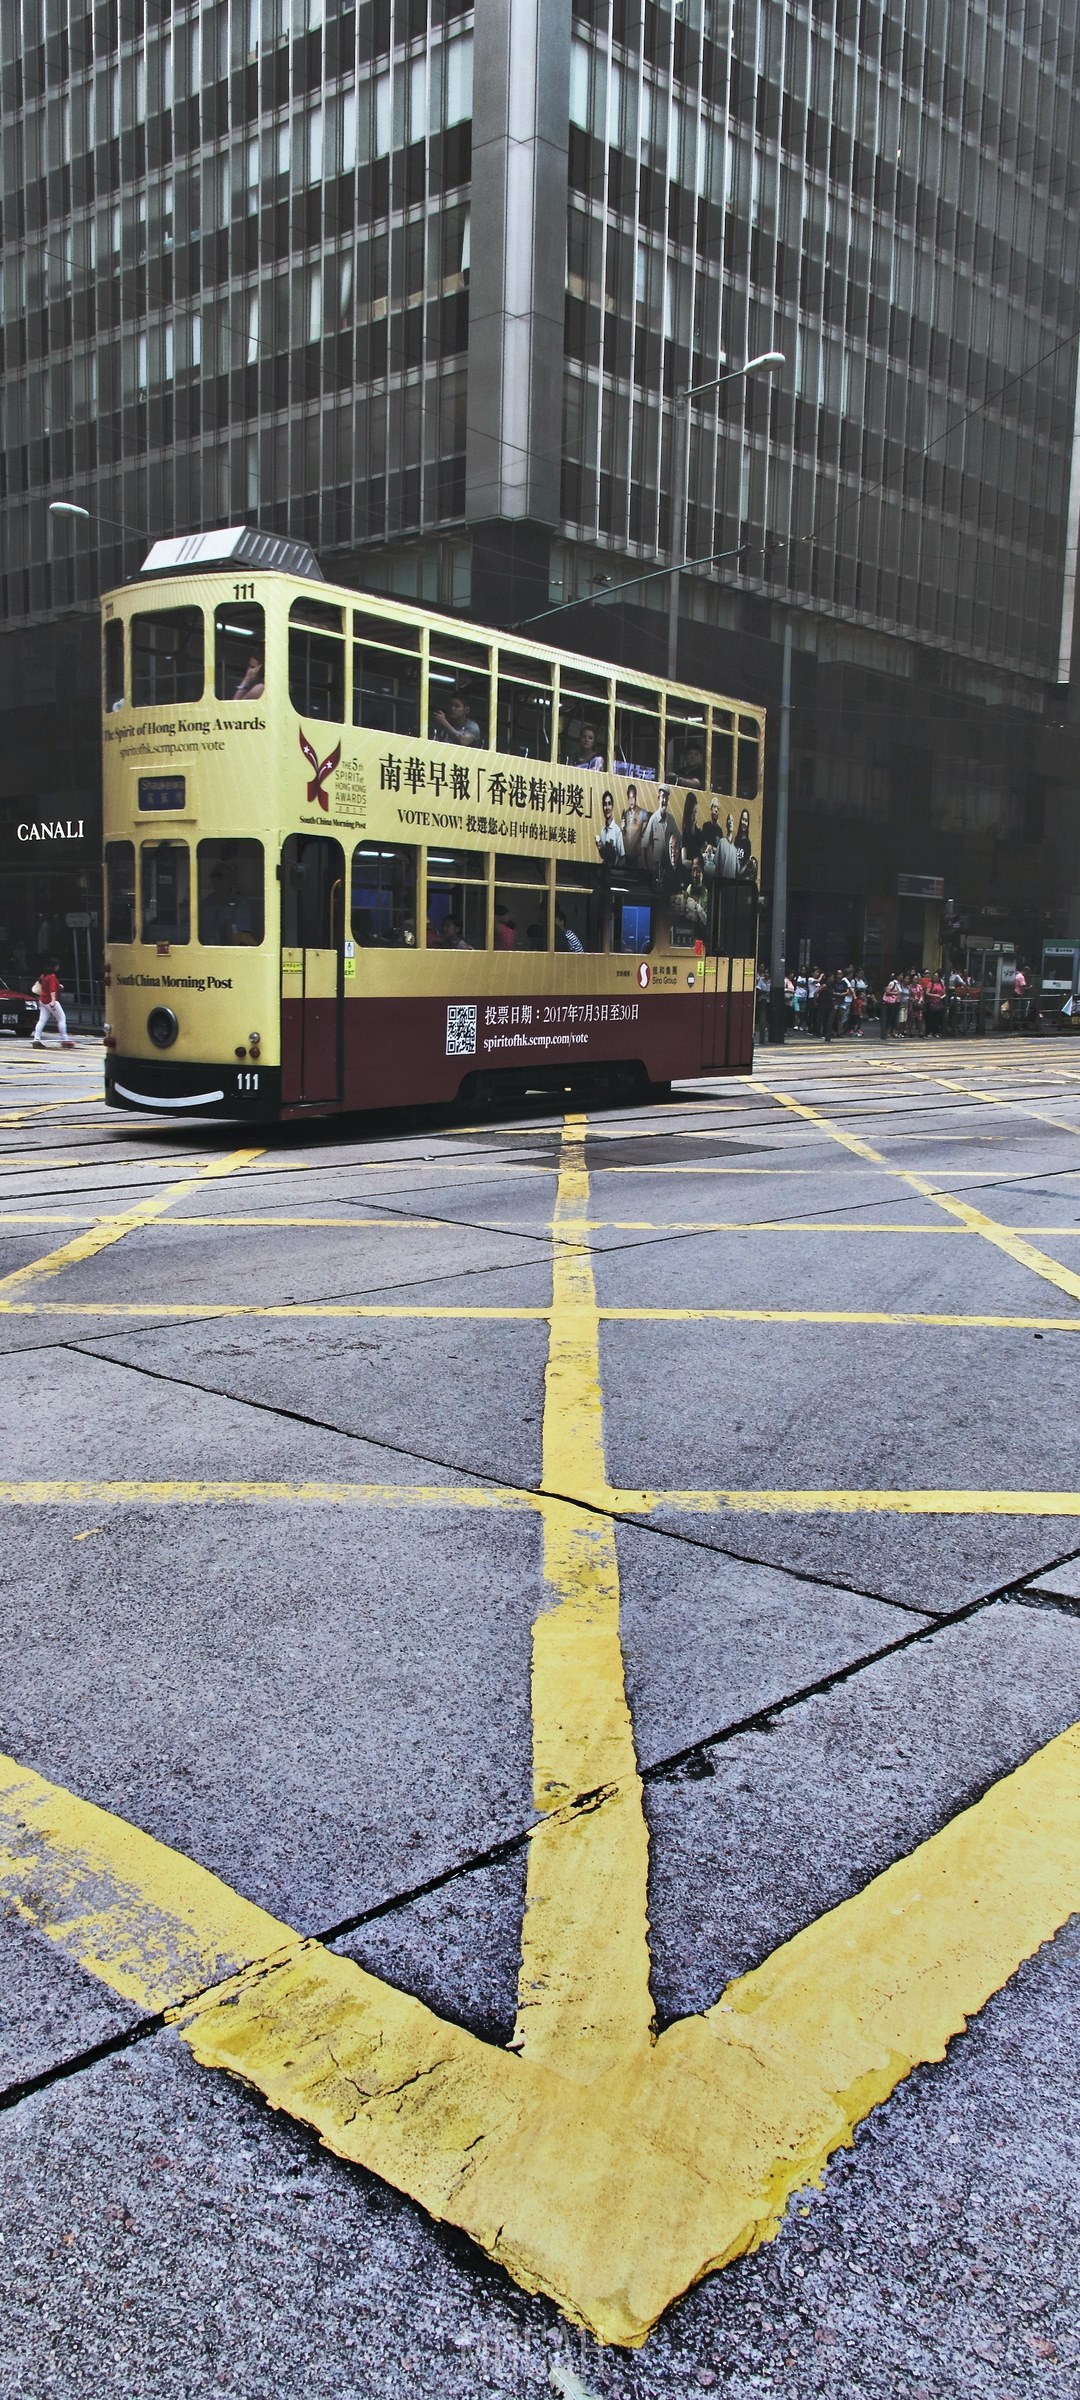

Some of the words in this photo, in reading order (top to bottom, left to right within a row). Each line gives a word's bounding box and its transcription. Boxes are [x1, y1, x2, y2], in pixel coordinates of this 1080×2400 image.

[233, 583, 255, 600] 111
[114, 726, 135, 743] Spirit
[137, 722, 147, 736] of
[148, 721, 176, 736] Hong
[178, 719, 211, 735] Kong
[213, 717, 266, 731] Awards
[342, 760, 352, 770] THE
[335, 770, 360, 782] SPIRIT
[335, 782, 351, 791] HONG
[352, 784, 367, 793] KONG
[335, 792, 367, 805] AWARDS
[299, 815, 316, 825] South
[316, 817, 332, 826] China
[332, 819, 355, 830] Morning
[355, 821, 366, 829] Post
[397, 809, 431, 826] VOTE
[431, 812, 463, 830] NOW!
[17, 820, 85, 841] CANALI
[116, 974, 135, 986] South
[135, 974, 161, 987] China
[162, 975, 206, 992] Morning
[207, 976, 233, 989] Post
[663, 976, 677, 985] Group
[483, 1032, 589, 1052] spiritofhk.scmp.com/vote
[236, 1073, 259, 1090] 111
